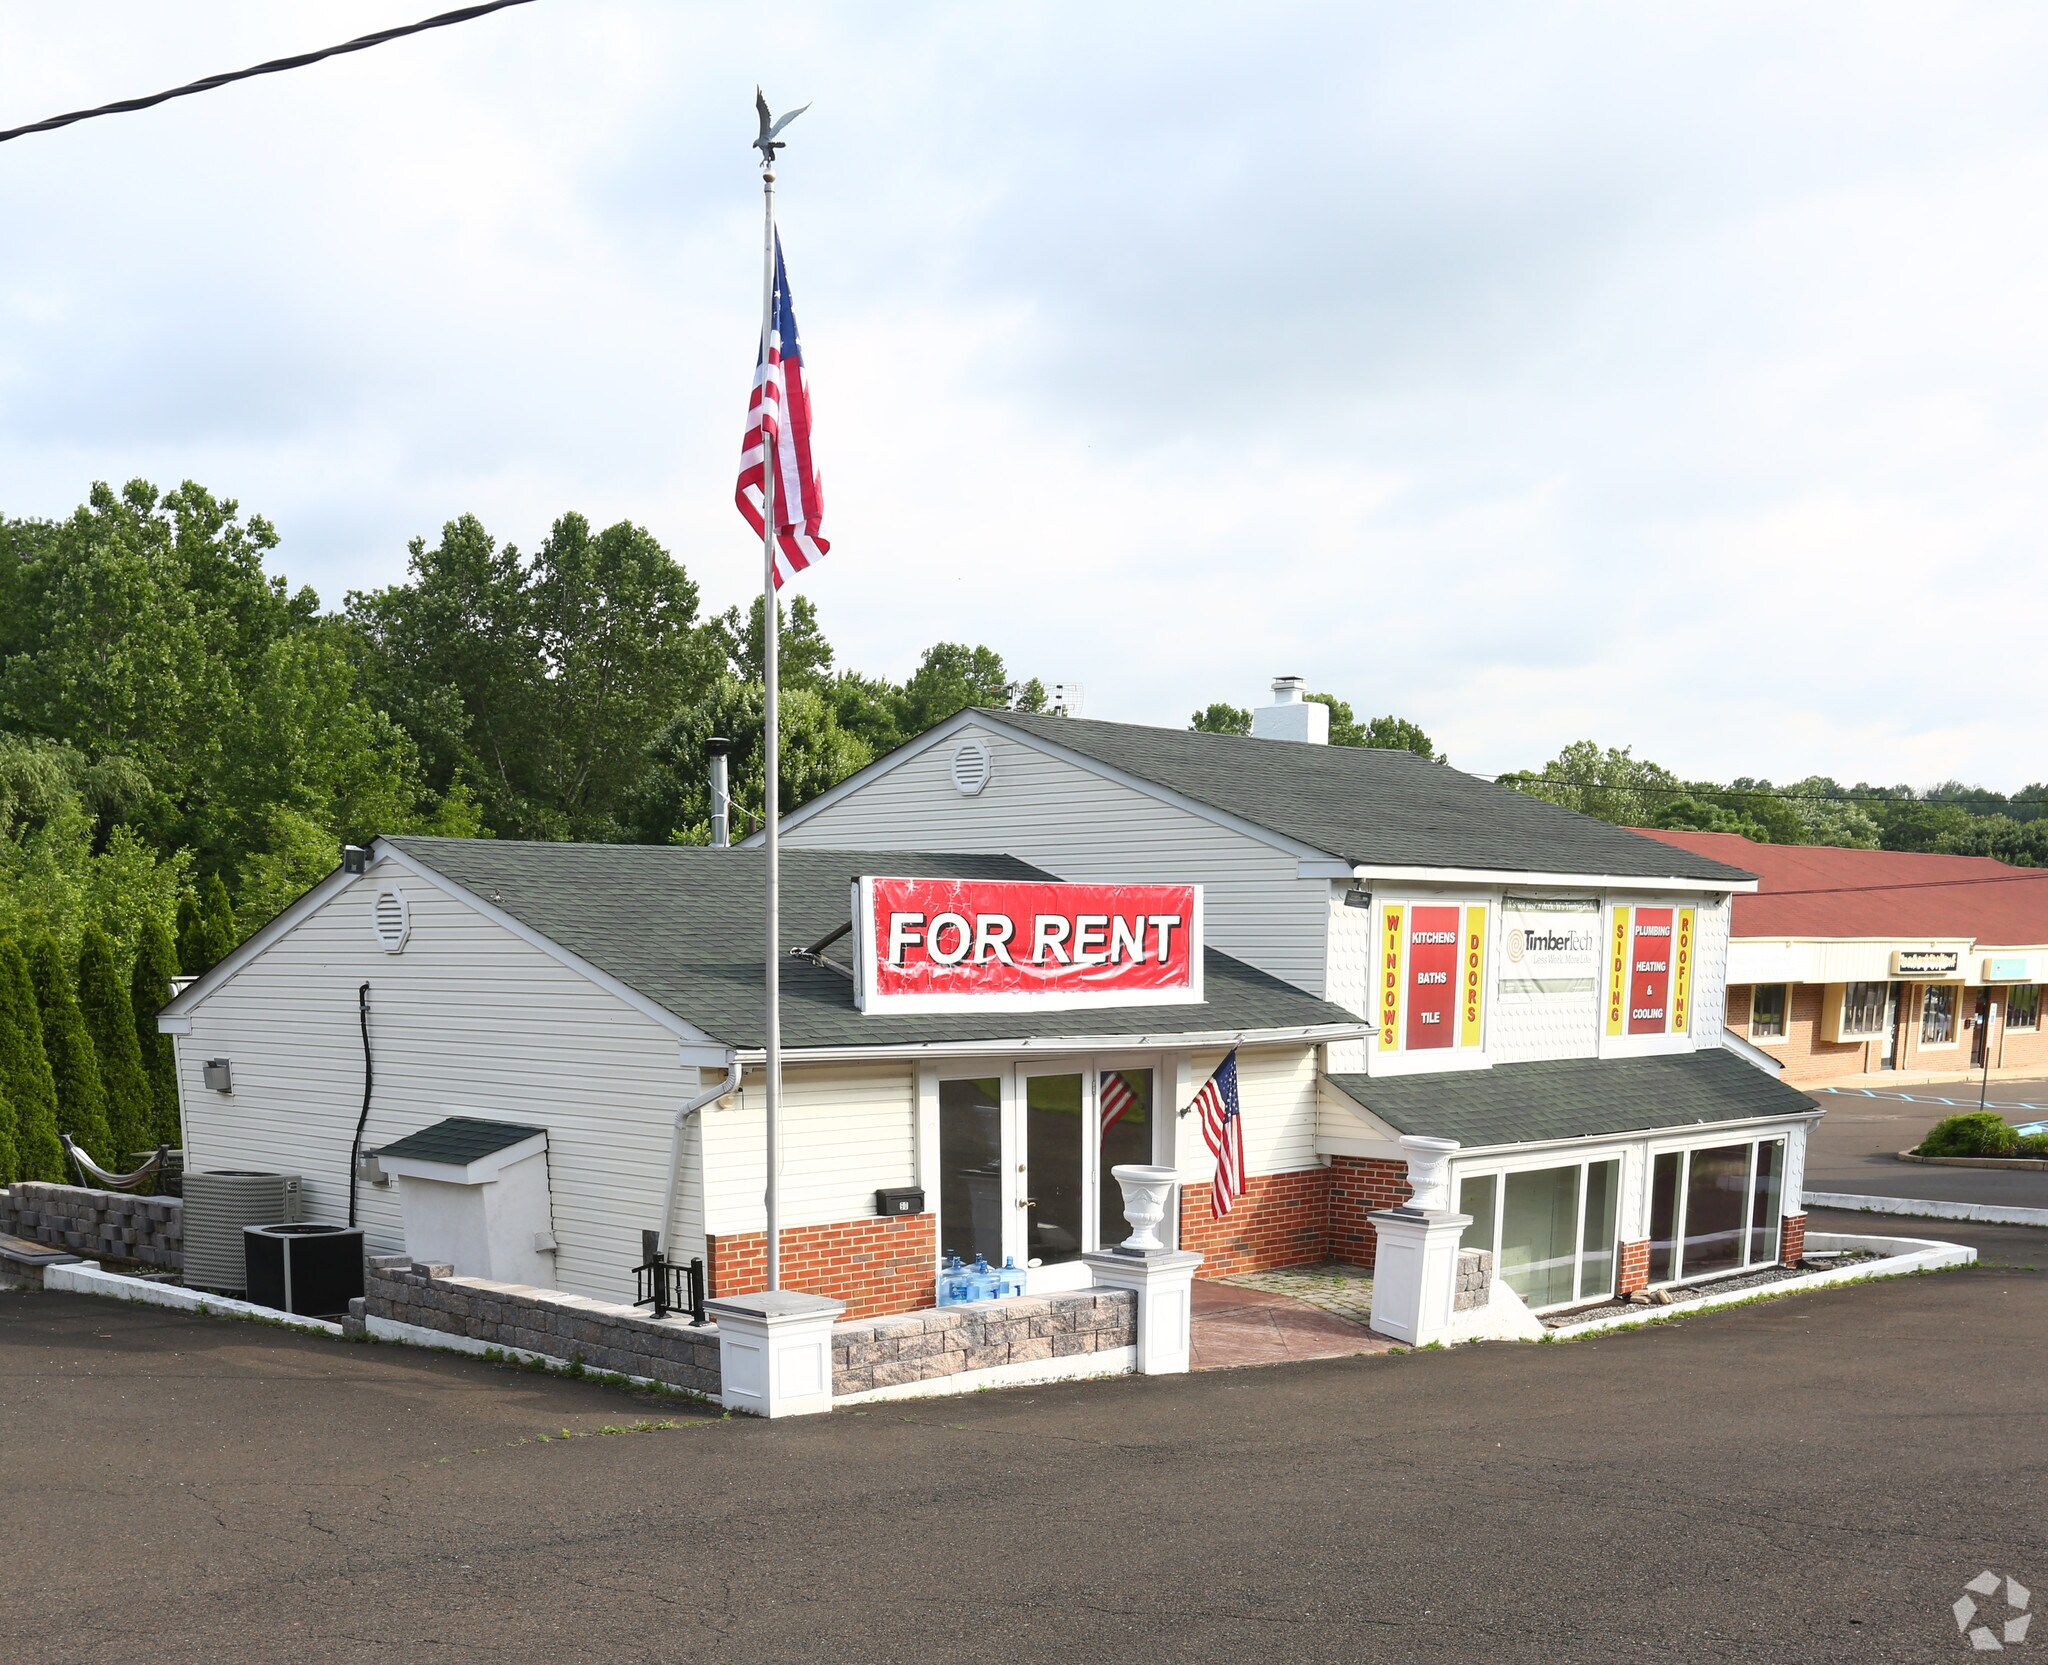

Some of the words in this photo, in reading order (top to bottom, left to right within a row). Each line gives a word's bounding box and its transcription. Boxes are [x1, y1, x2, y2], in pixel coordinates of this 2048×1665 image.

[1411, 931, 1456, 945] KITCHENS
[1634, 925, 1671, 937] PLUMBING
[888, 912, 1016, 967] FOR
[1032, 913, 1182, 966] RENT
[1524, 929, 1593, 951] TimberTech
[1611, 924, 1624, 1022] SIDING
[1636, 961, 1667, 973] HEATING
[1675, 917, 1689, 1028] ROOFING
[1383, 915, 1400, 1044] WINDOWS
[1417, 971, 1447, 985] BATHS
[1467, 934, 1480, 1022] DOORS
[1646, 984, 1654, 996] &
[1421, 1011, 1440, 1025] TILE
[1632, 1008, 1664, 1020] COOLING
